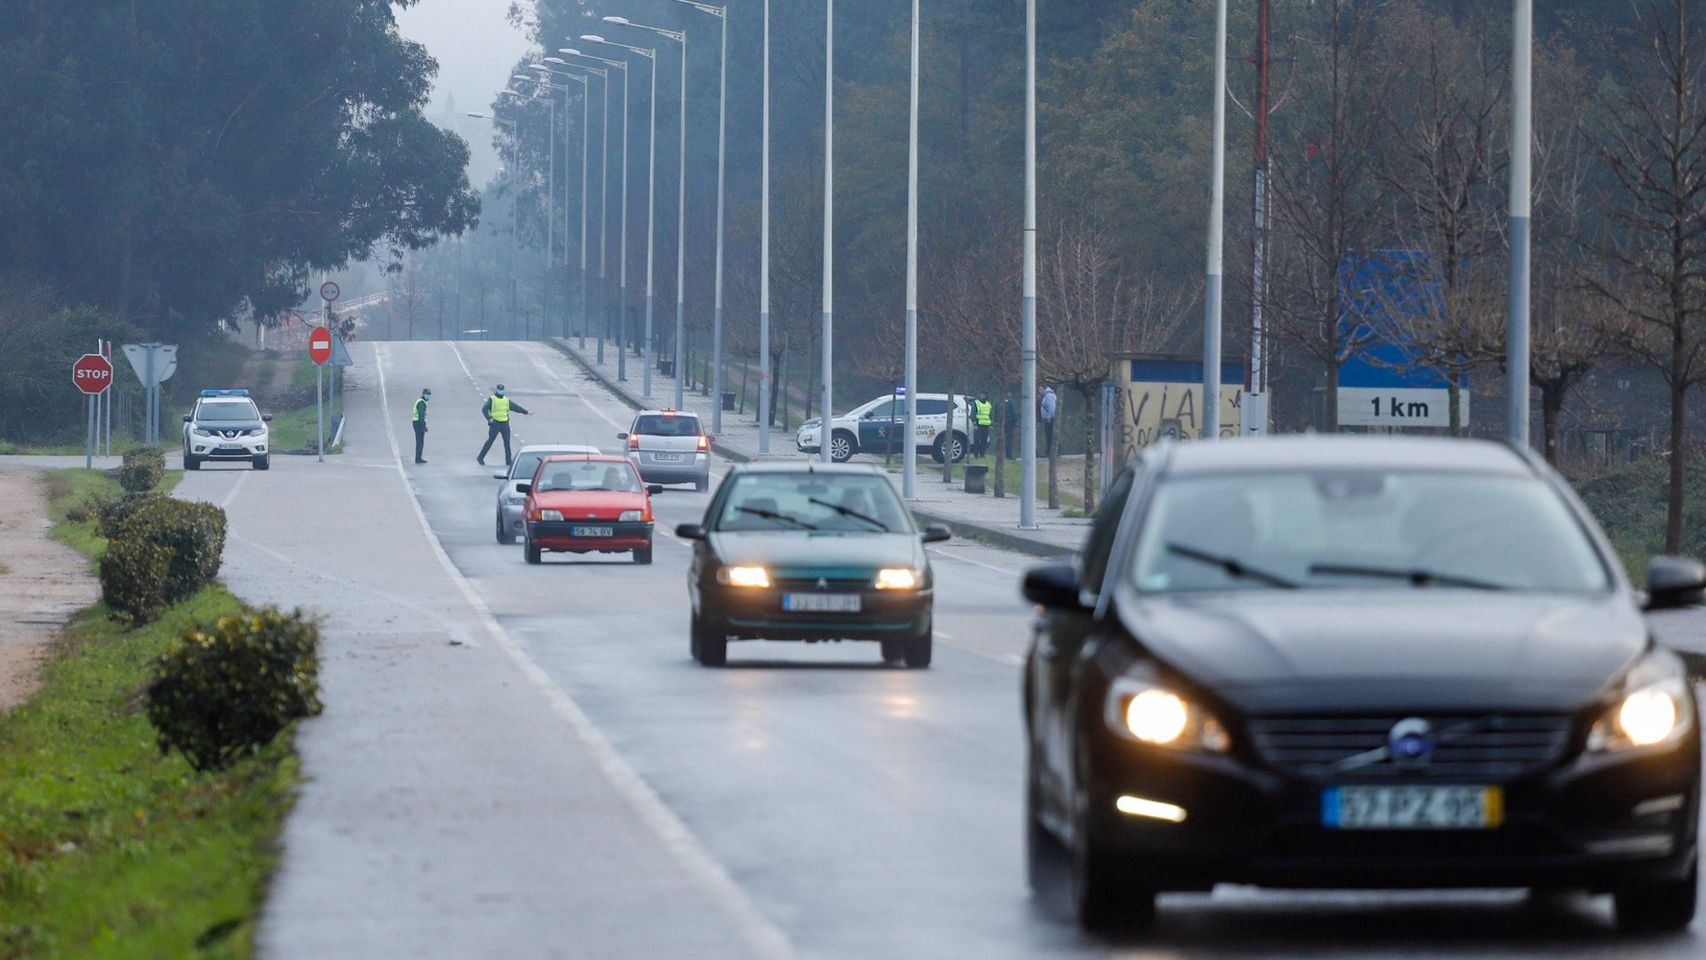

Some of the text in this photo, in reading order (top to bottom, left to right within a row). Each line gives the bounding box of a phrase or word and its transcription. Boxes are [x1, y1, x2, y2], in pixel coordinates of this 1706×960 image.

[76, 369, 109, 379] STOP
[1371, 397, 1429, 417] 1 km
